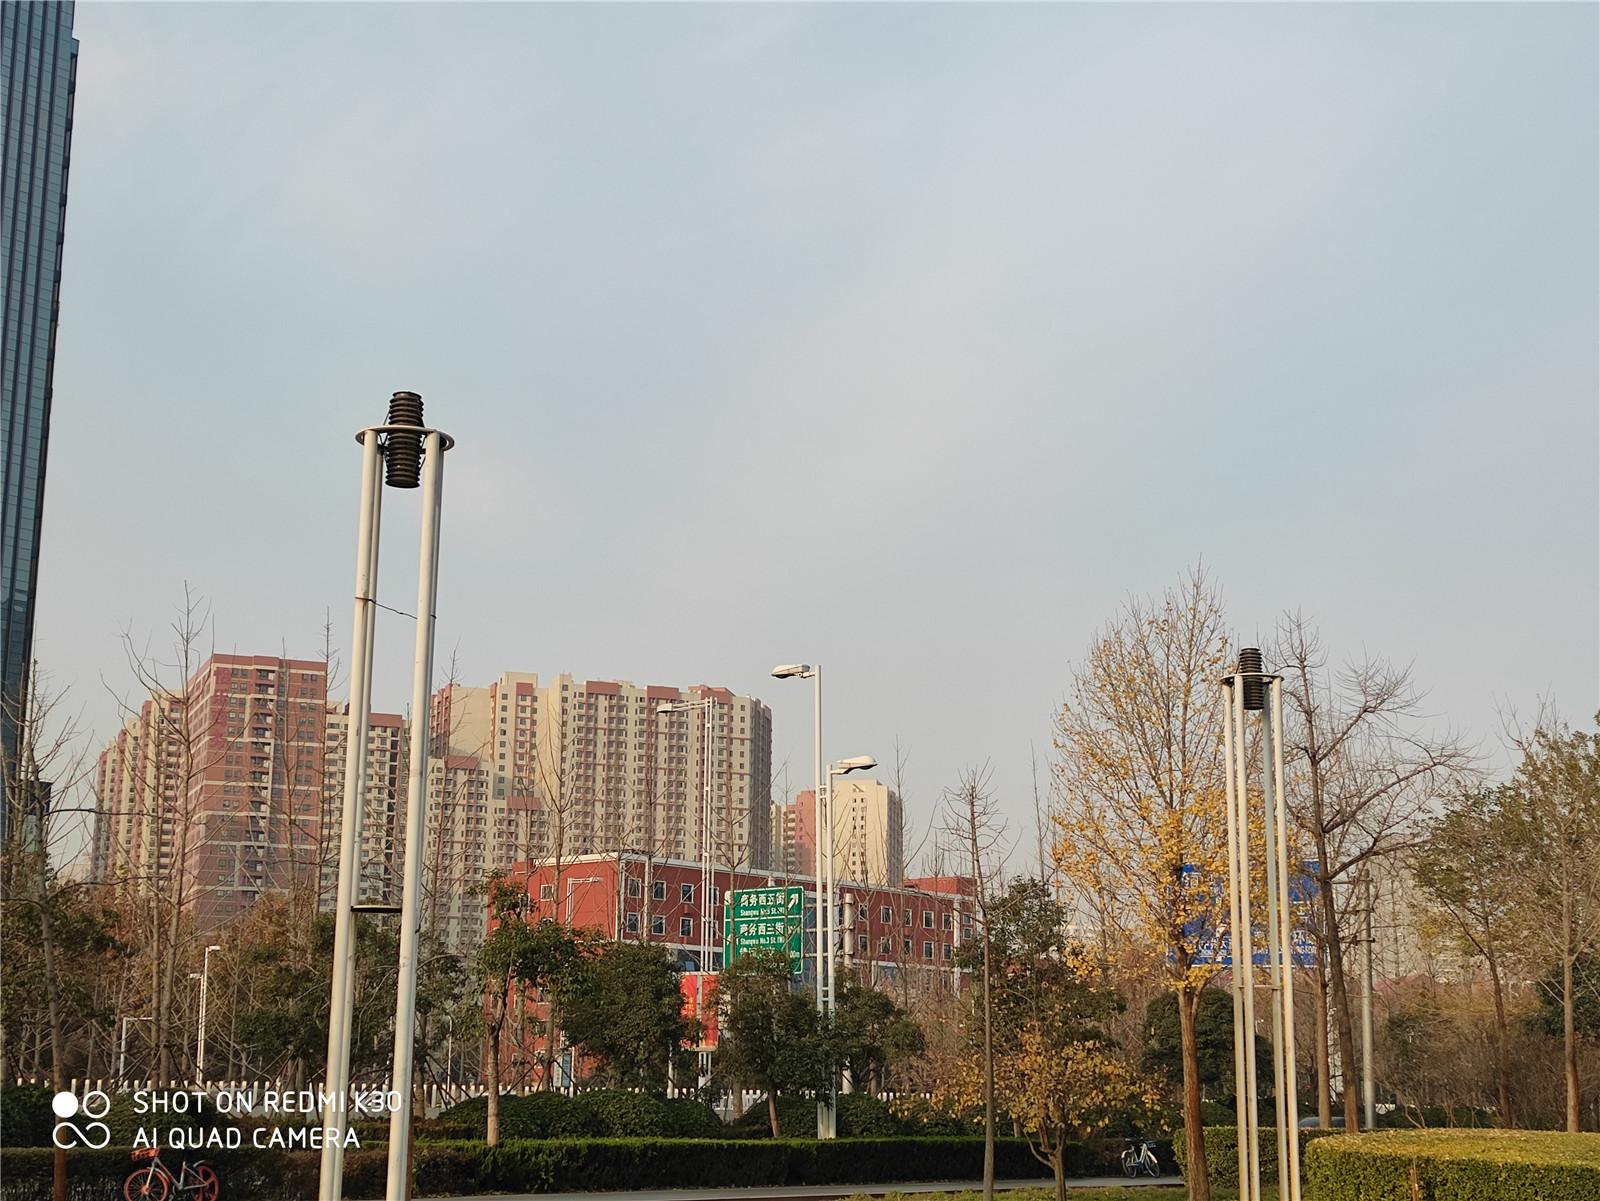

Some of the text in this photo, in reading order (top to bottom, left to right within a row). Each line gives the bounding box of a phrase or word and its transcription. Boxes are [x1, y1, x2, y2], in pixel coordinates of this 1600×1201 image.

[740, 892, 785, 907] 商务西五街
[739, 922, 784, 936] 商务西三街
